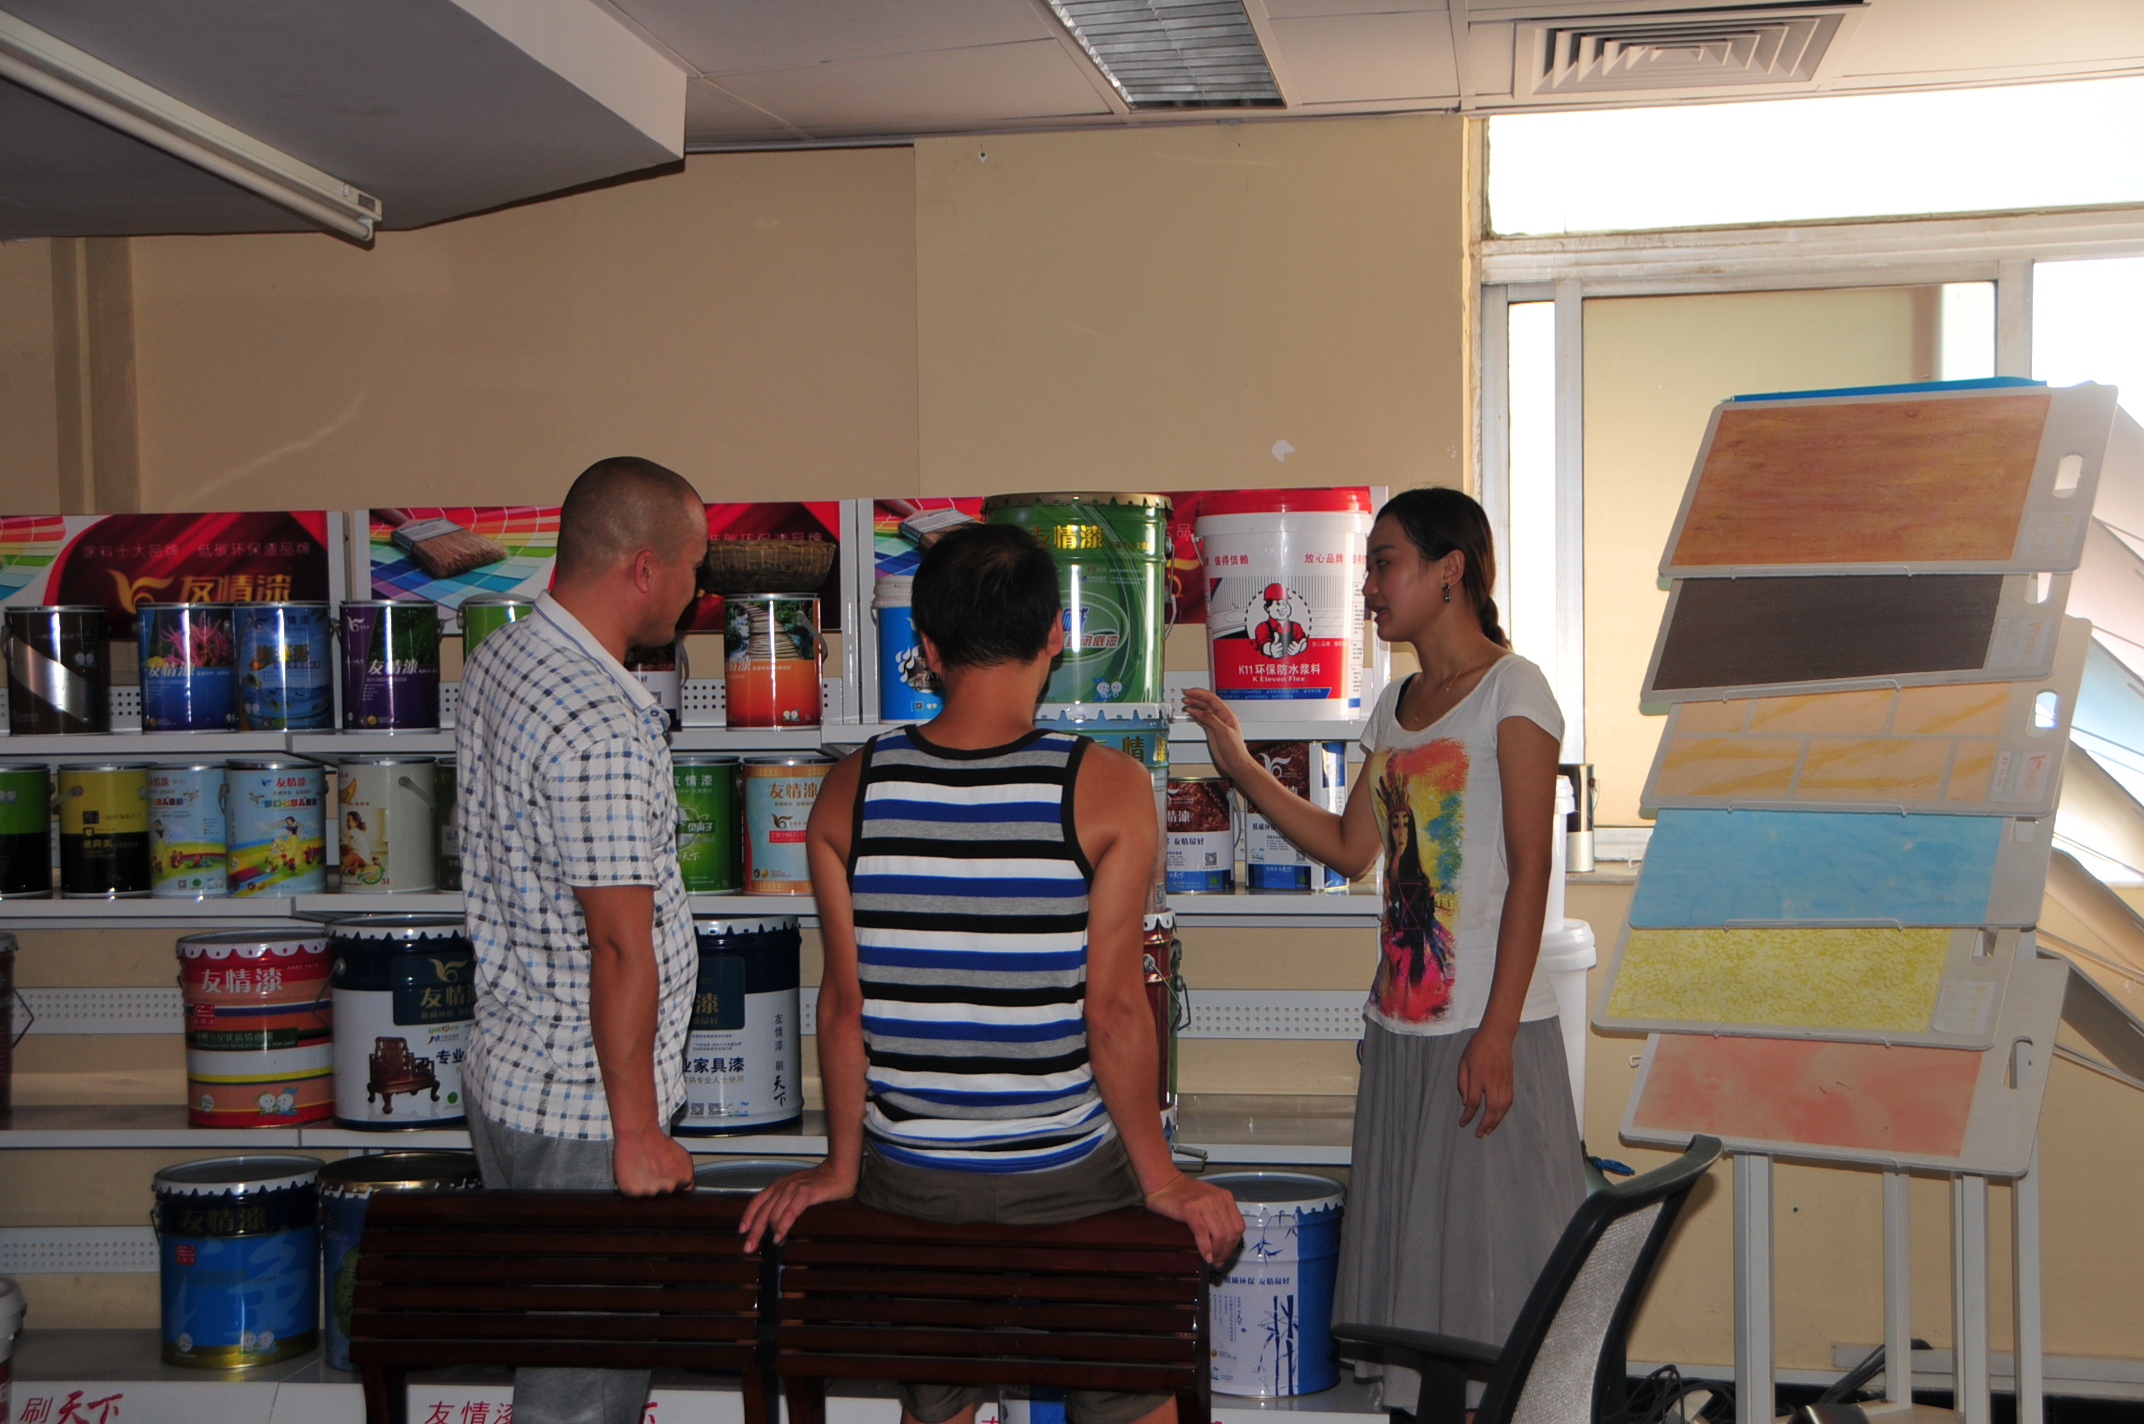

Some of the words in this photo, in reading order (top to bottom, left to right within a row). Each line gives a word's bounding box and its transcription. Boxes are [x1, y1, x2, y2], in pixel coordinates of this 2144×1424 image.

[83, 544, 180, 559] 涂料十大品牌
[198, 541, 312, 558] 低碳环保漆品牌
[1214, 554, 1250, 566] 值得信赖
[1304, 553, 1344, 564] 放心品牌
[181, 574, 294, 601] 友情漆
[1288, 675, 1306, 683] Flex
[769, 782, 819, 799] 友情漆
[201, 967, 283, 993] 友情漆
[774, 1013, 783, 1052] 友情漆
[436, 1048, 465, 1065] 专业
[773, 1060, 786, 1106] 刷天下
[182, 1206, 266, 1234] 友情漆
[19, 1391, 124, 1424] 刷天下
